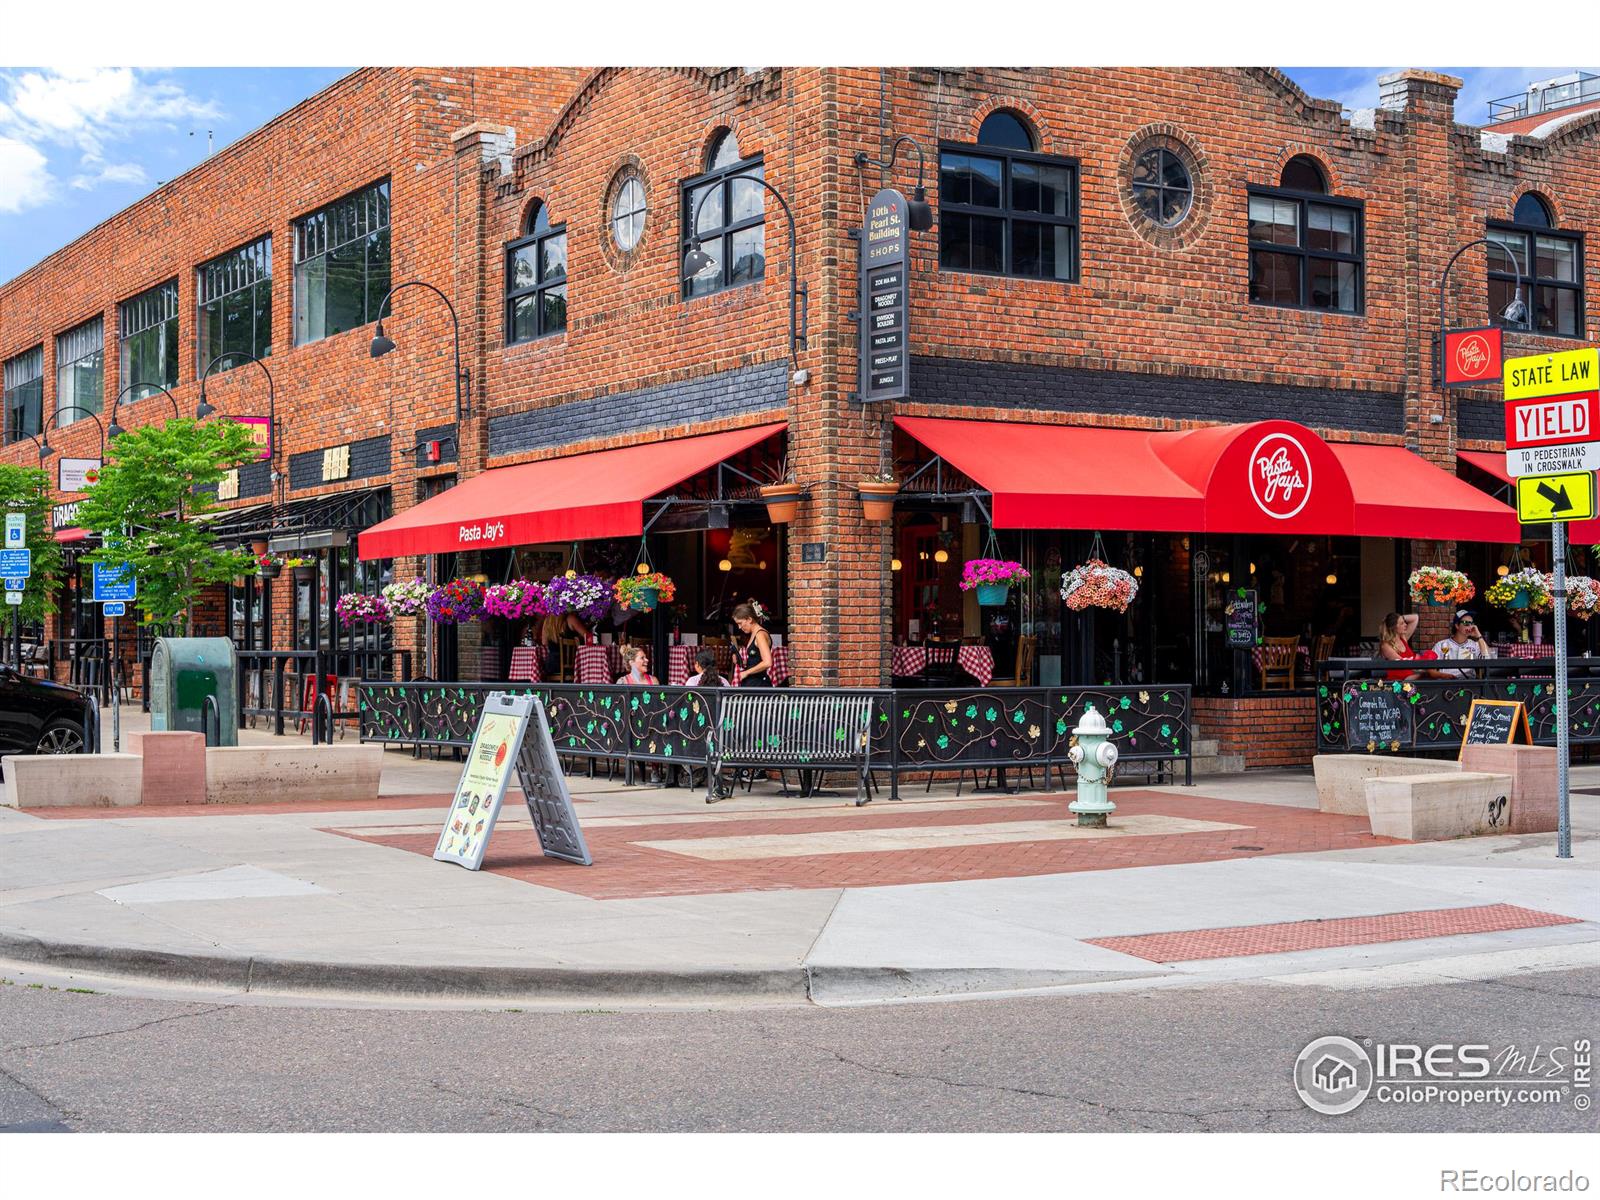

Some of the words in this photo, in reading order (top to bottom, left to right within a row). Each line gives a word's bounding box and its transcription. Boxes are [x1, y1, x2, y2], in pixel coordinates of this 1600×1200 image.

[872, 206, 888, 218] 10th
[870, 216, 889, 230] Pearl
[890, 214, 901, 225] St.
[869, 227, 900, 241] Building
[870, 244, 900, 258] SHOPS
[1460, 340, 1480, 360] Pasta
[1512, 366, 1553, 388] STATE
[1562, 361, 1590, 381] LAW
[1519, 403, 1586, 438] YIELD
[1257, 446, 1293, 479] Pasta
[1521, 451, 1531, 462] TO
[1534, 446, 1586, 461] PEDESTRIANS
[1525, 463, 1533, 473] IN
[1537, 460, 1582, 472] CROSSWALK
[1264, 470, 1304, 502] Jay's
[459, 525, 481, 542] Pasta
[482, 521, 504, 541] Jay's
